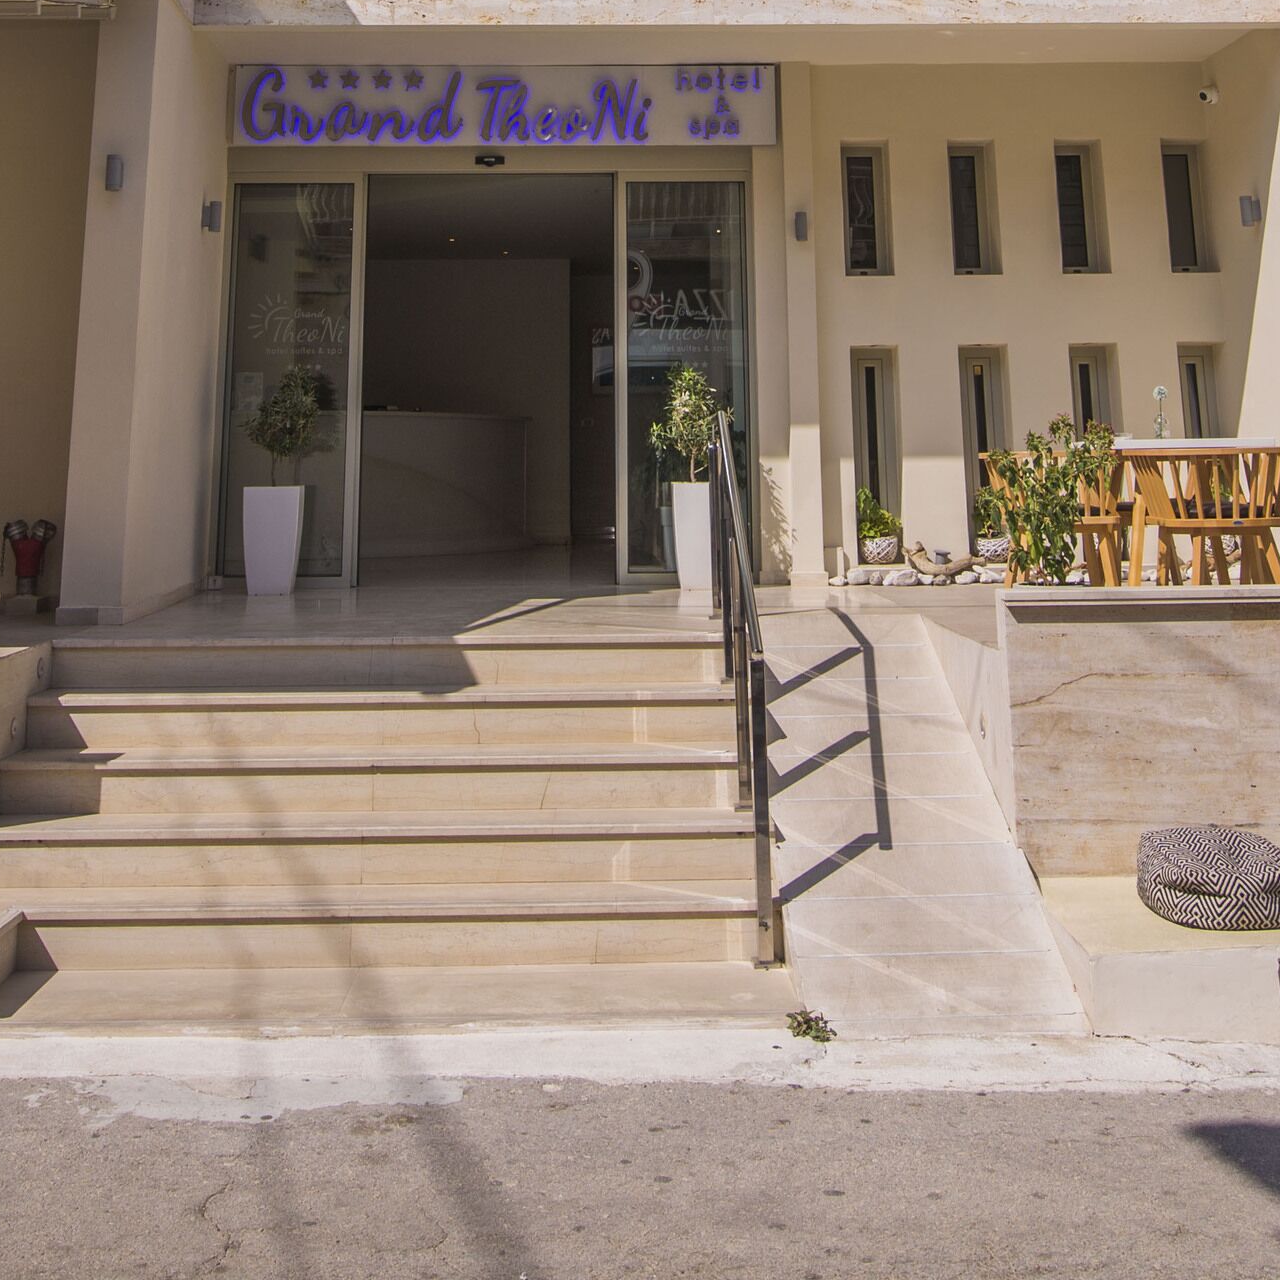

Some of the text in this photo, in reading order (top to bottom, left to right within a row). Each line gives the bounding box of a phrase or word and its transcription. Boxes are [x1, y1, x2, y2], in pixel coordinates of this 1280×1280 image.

[674, 66, 761, 91] hotel
[241, 68, 653, 142] Grand TheoNi
[715, 94, 731, 114] &
[687, 116, 740, 141] spa
[294, 307, 325, 319] Grand
